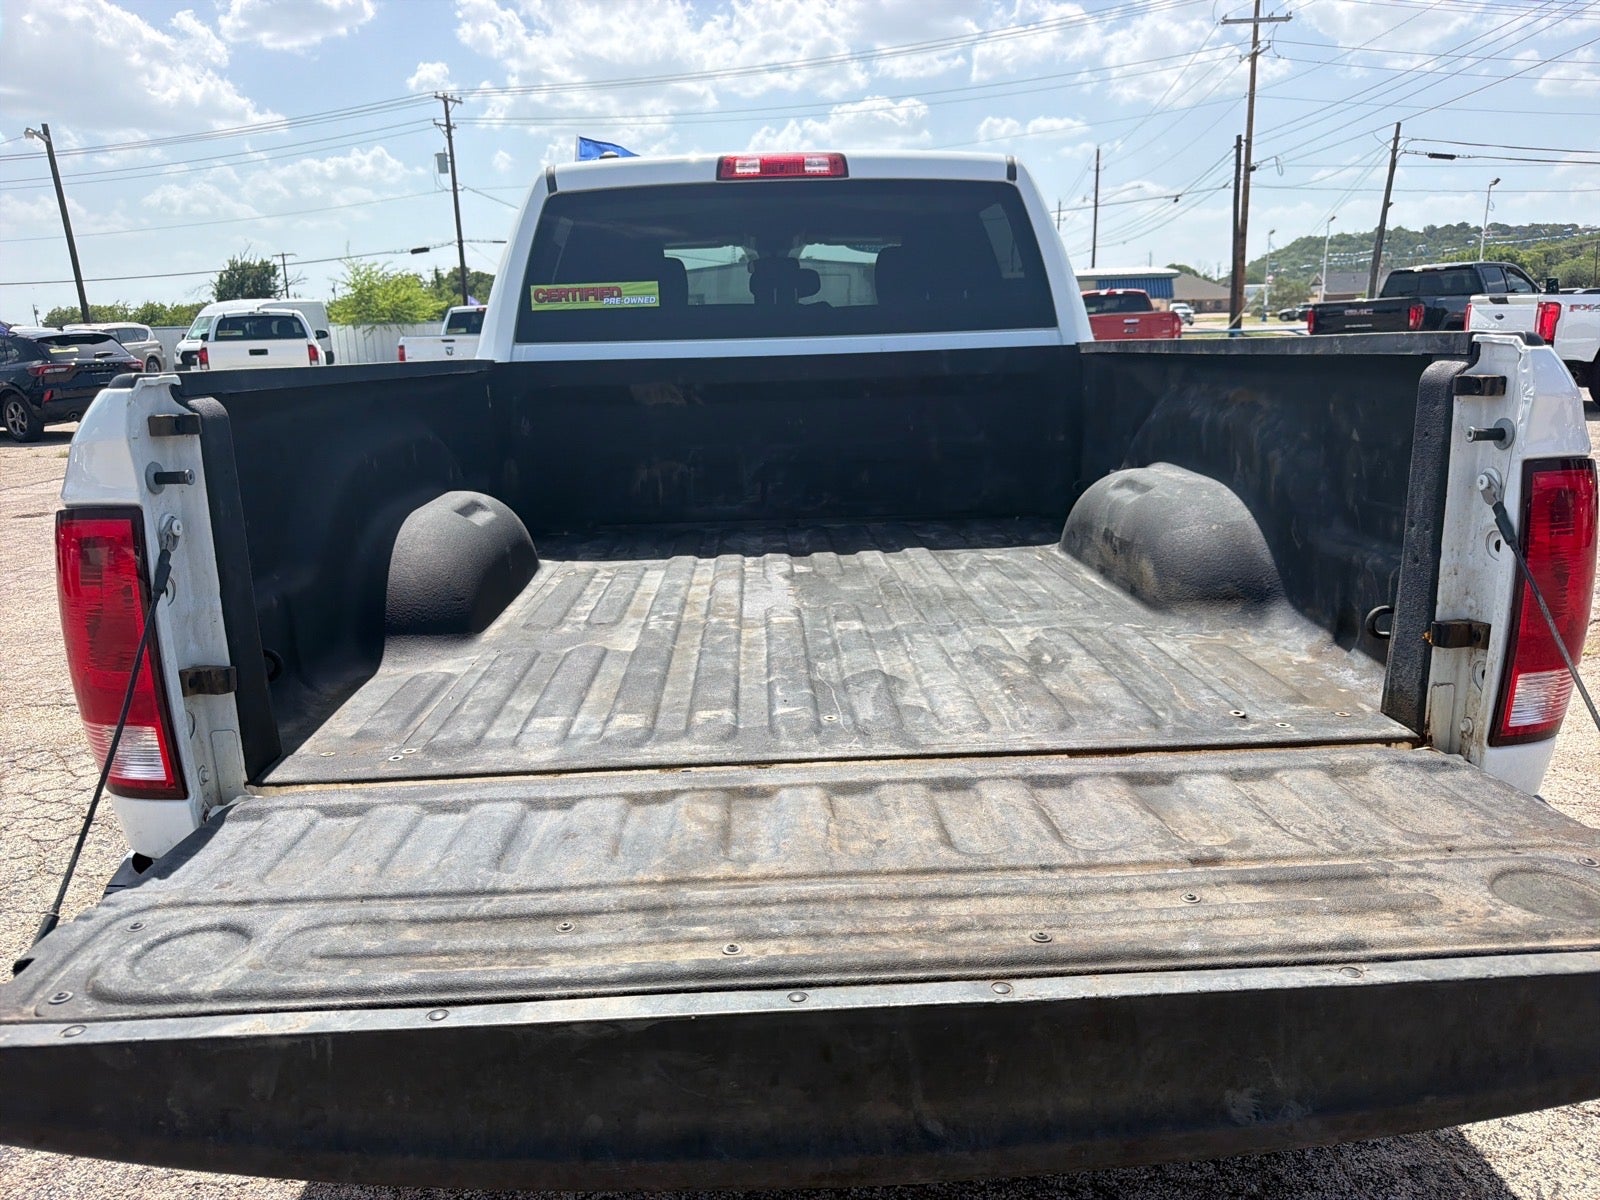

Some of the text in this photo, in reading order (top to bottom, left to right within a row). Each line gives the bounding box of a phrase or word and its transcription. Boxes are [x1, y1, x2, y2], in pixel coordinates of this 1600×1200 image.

[534, 286, 623, 304] CERTIFIED
[603, 296, 656, 305] PRE-OWNED
[1344, 308, 1374, 316] GMC
